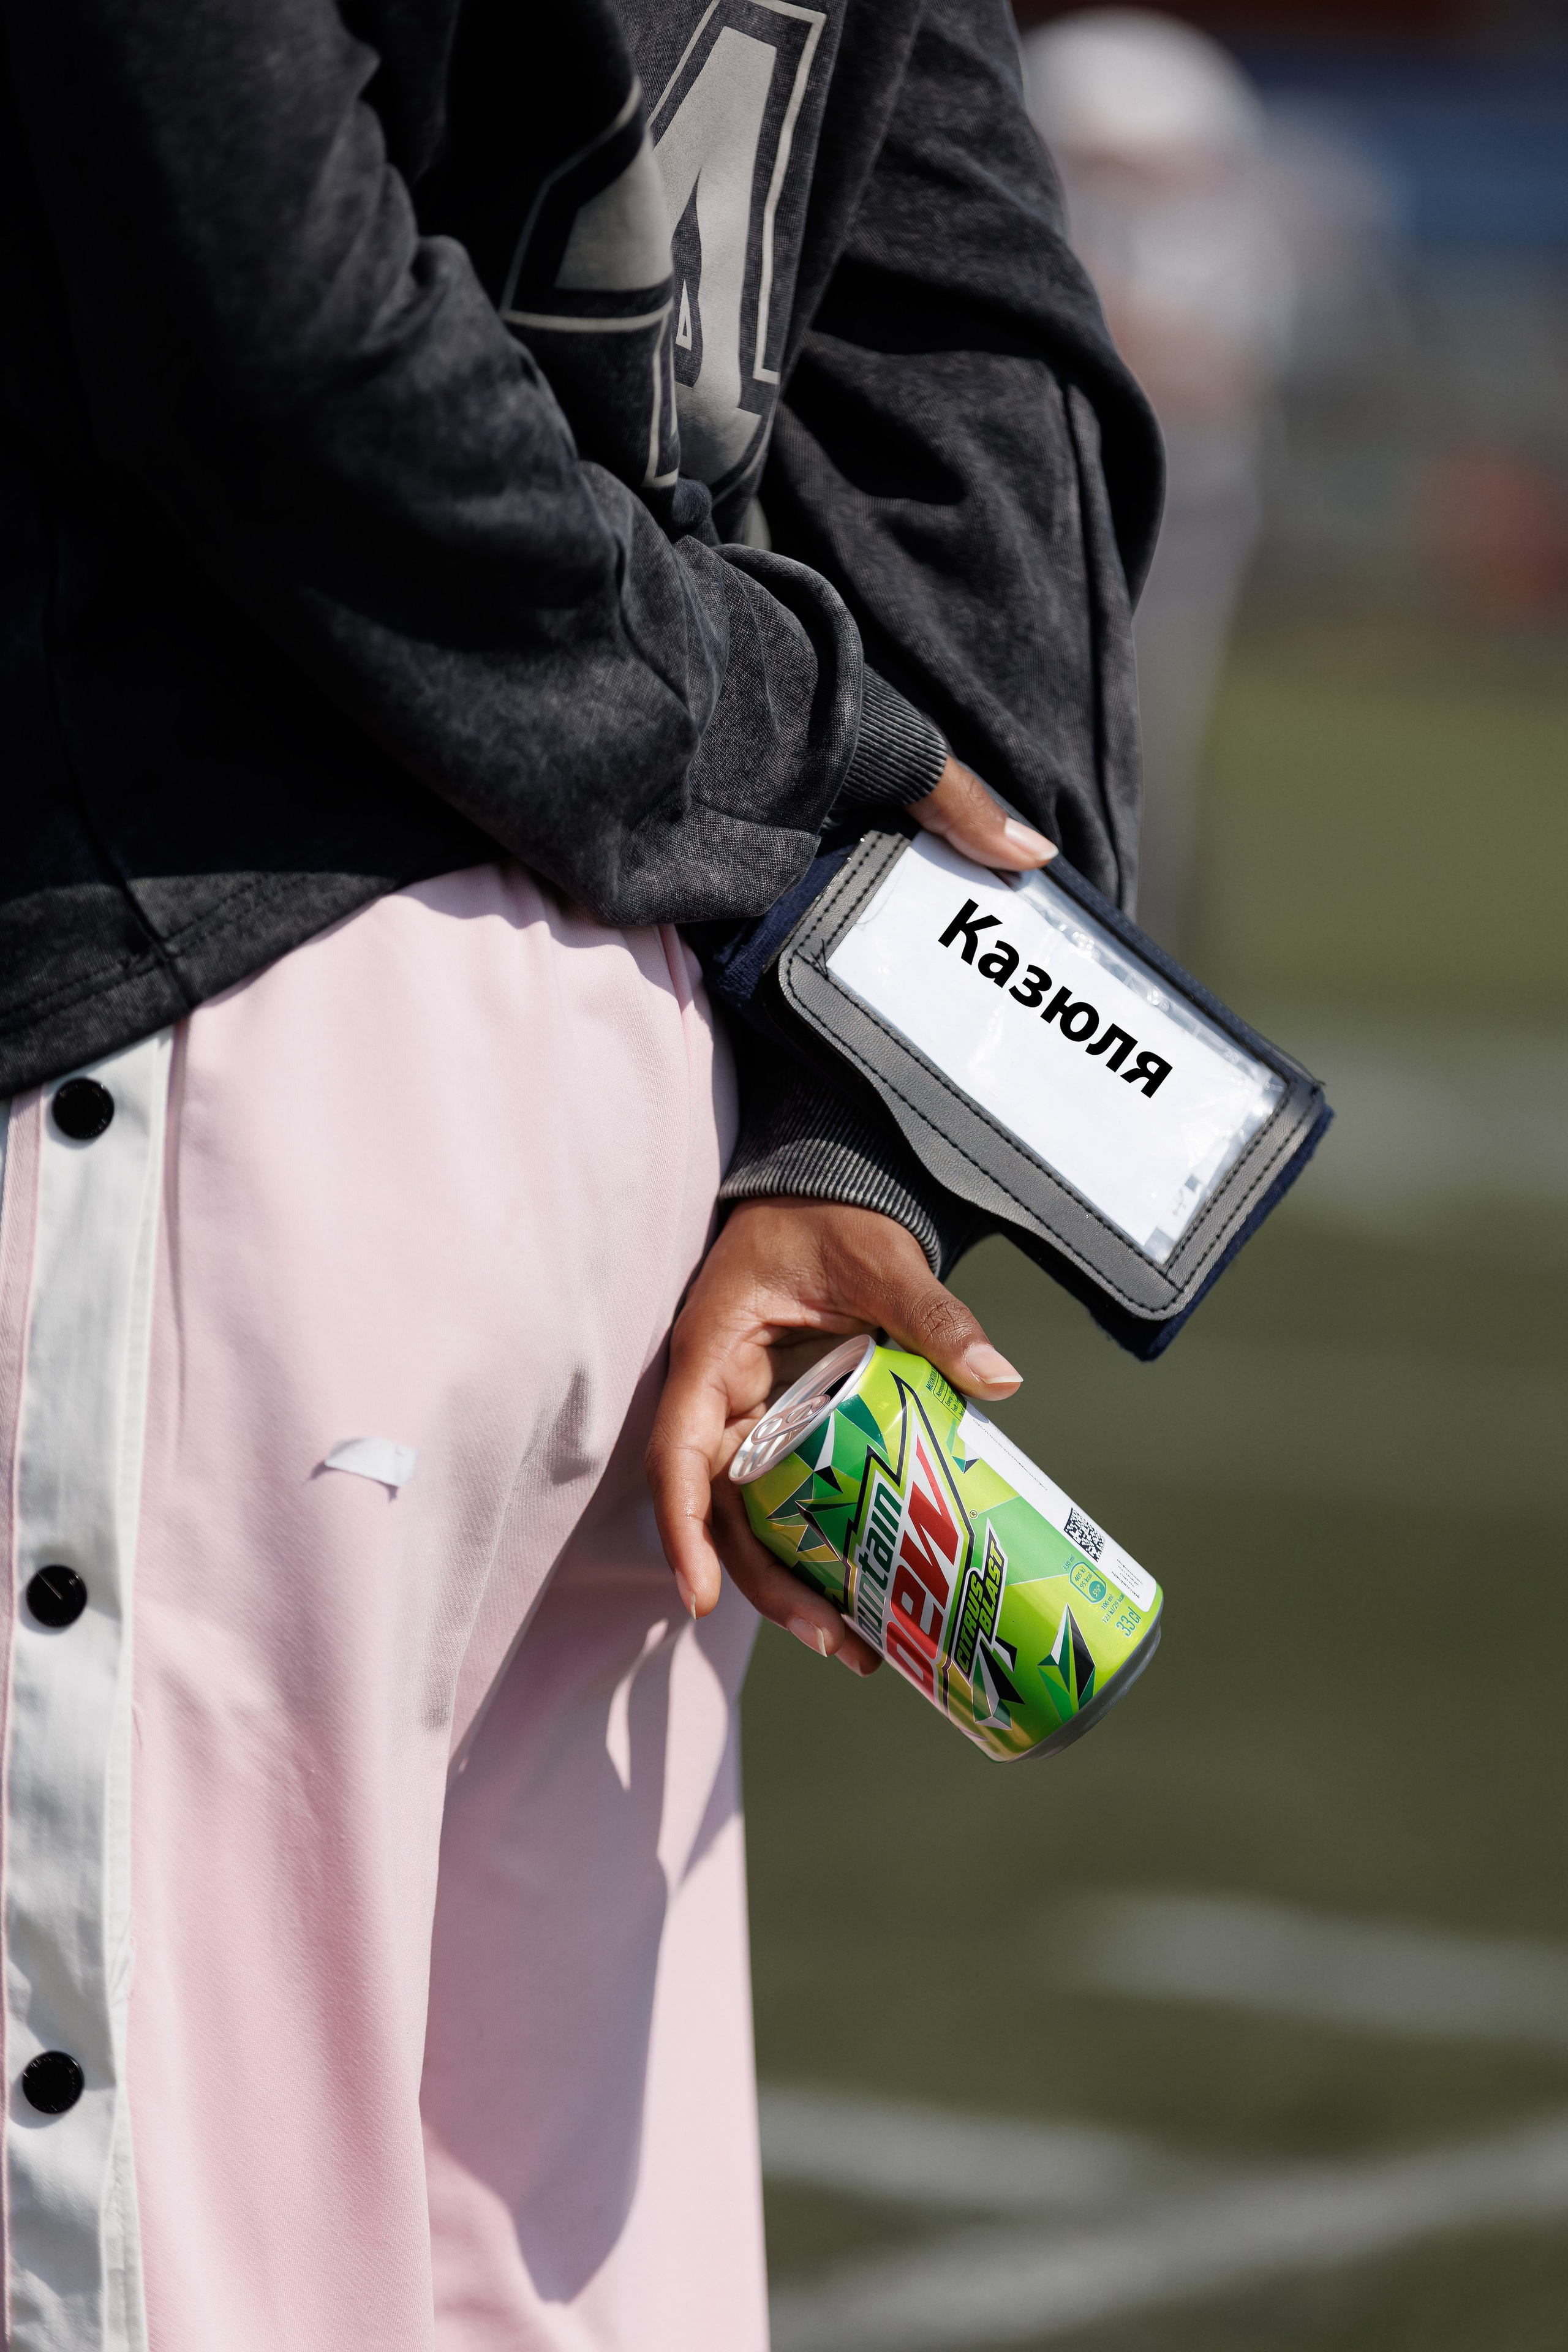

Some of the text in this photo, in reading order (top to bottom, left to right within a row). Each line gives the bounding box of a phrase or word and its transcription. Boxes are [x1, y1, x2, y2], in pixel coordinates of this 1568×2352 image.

[938, 898, 1174, 1099] Казюля
[858, 1482, 902, 1651] ountain
[1063, 1562, 1071, 1571] 330
[1074, 1570, 1083, 1582] 405
[979, 1540, 1003, 1630] BLAST
[1101, 1599, 1110, 1610] 100
[1102, 1613, 1110, 1624] 123
[956, 1574, 984, 1673] CITRUS
[1116, 1615, 1135, 1637] 33
[1128, 1606, 1141, 1624] cl
